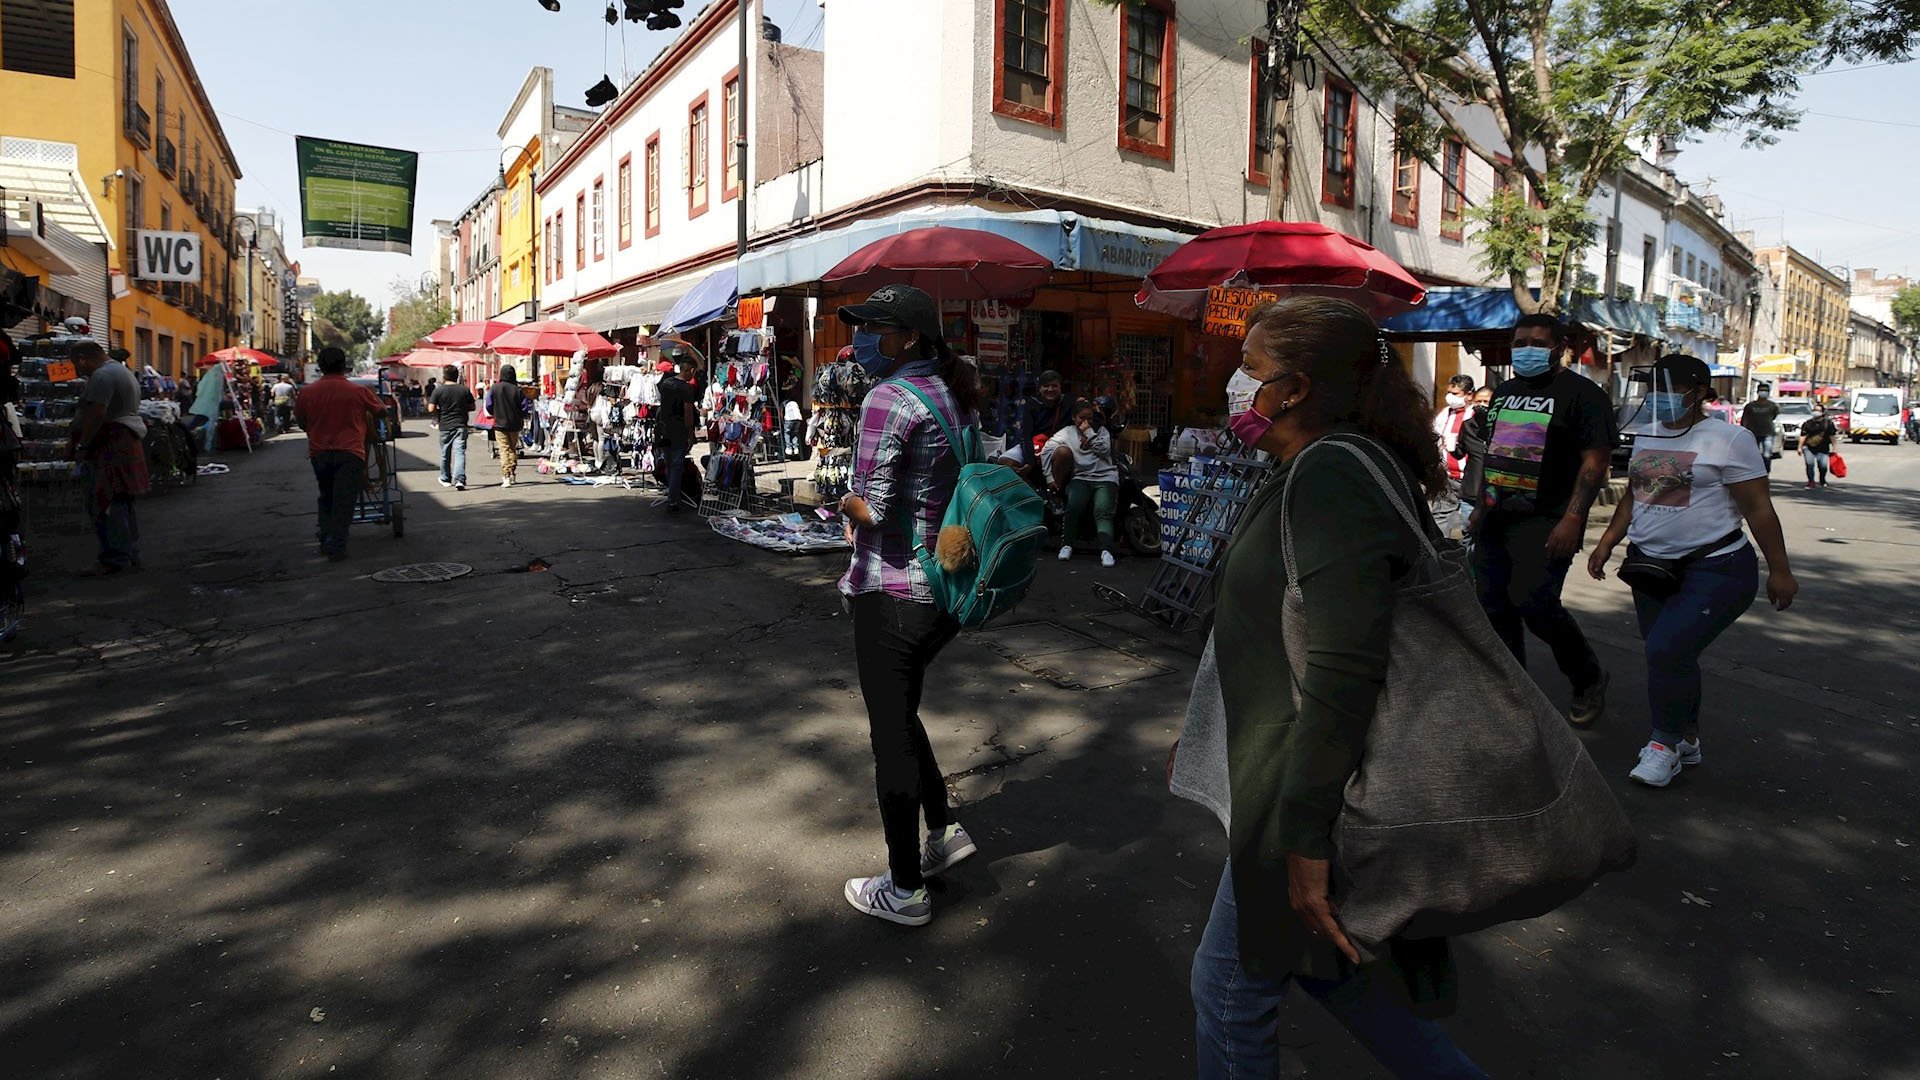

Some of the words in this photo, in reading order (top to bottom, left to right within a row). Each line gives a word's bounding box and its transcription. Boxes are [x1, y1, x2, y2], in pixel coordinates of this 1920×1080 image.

[328, 142, 348, 150] SANA
[349, 145, 385, 155] DISTANCIA
[335, 149, 363, 158] CENTRO
[144, 236, 194, 275] WC
[1101, 244, 1167, 269] ABARROTE
[1503, 395, 1555, 414] NASA
